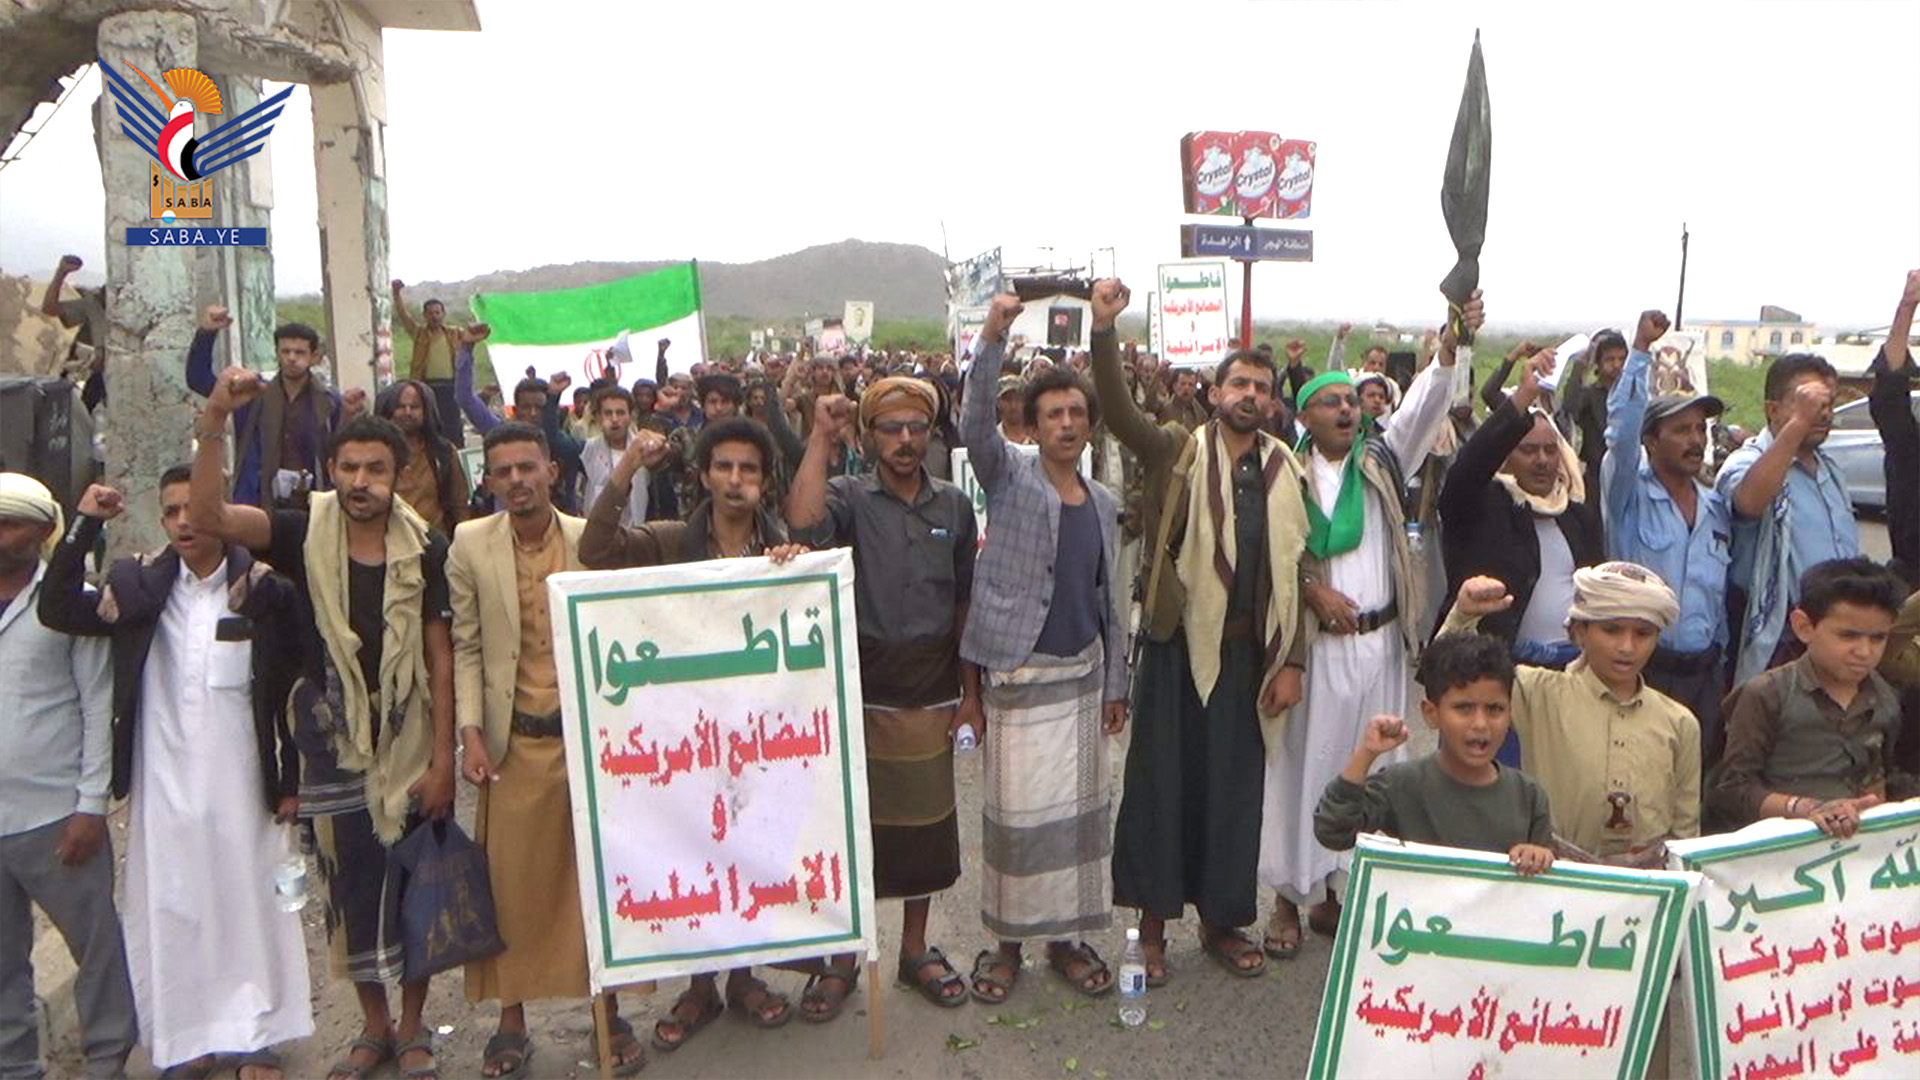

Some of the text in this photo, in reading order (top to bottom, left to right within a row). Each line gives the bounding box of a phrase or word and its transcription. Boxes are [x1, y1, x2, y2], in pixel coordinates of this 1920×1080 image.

[1236, 161, 1273, 188] Crystal
[1278, 168, 1311, 191] Crystal
[587, 605, 827, 706] قاطعوا
[598, 705, 831, 787] البضائع الأمريكية
[711, 791, 729, 842] و
[615, 850, 842, 933] الإسرائيلية
[1714, 840, 1861, 934] أكبر
[1371, 891, 1641, 972] قاطعوا
[1718, 915, 1849, 981] لأمريكا
[1355, 979, 1623, 1056] البضائع الأمريكية
[1726, 978, 1852, 1044] لإسرائيل
[1829, 1028, 1879, 1077] على
